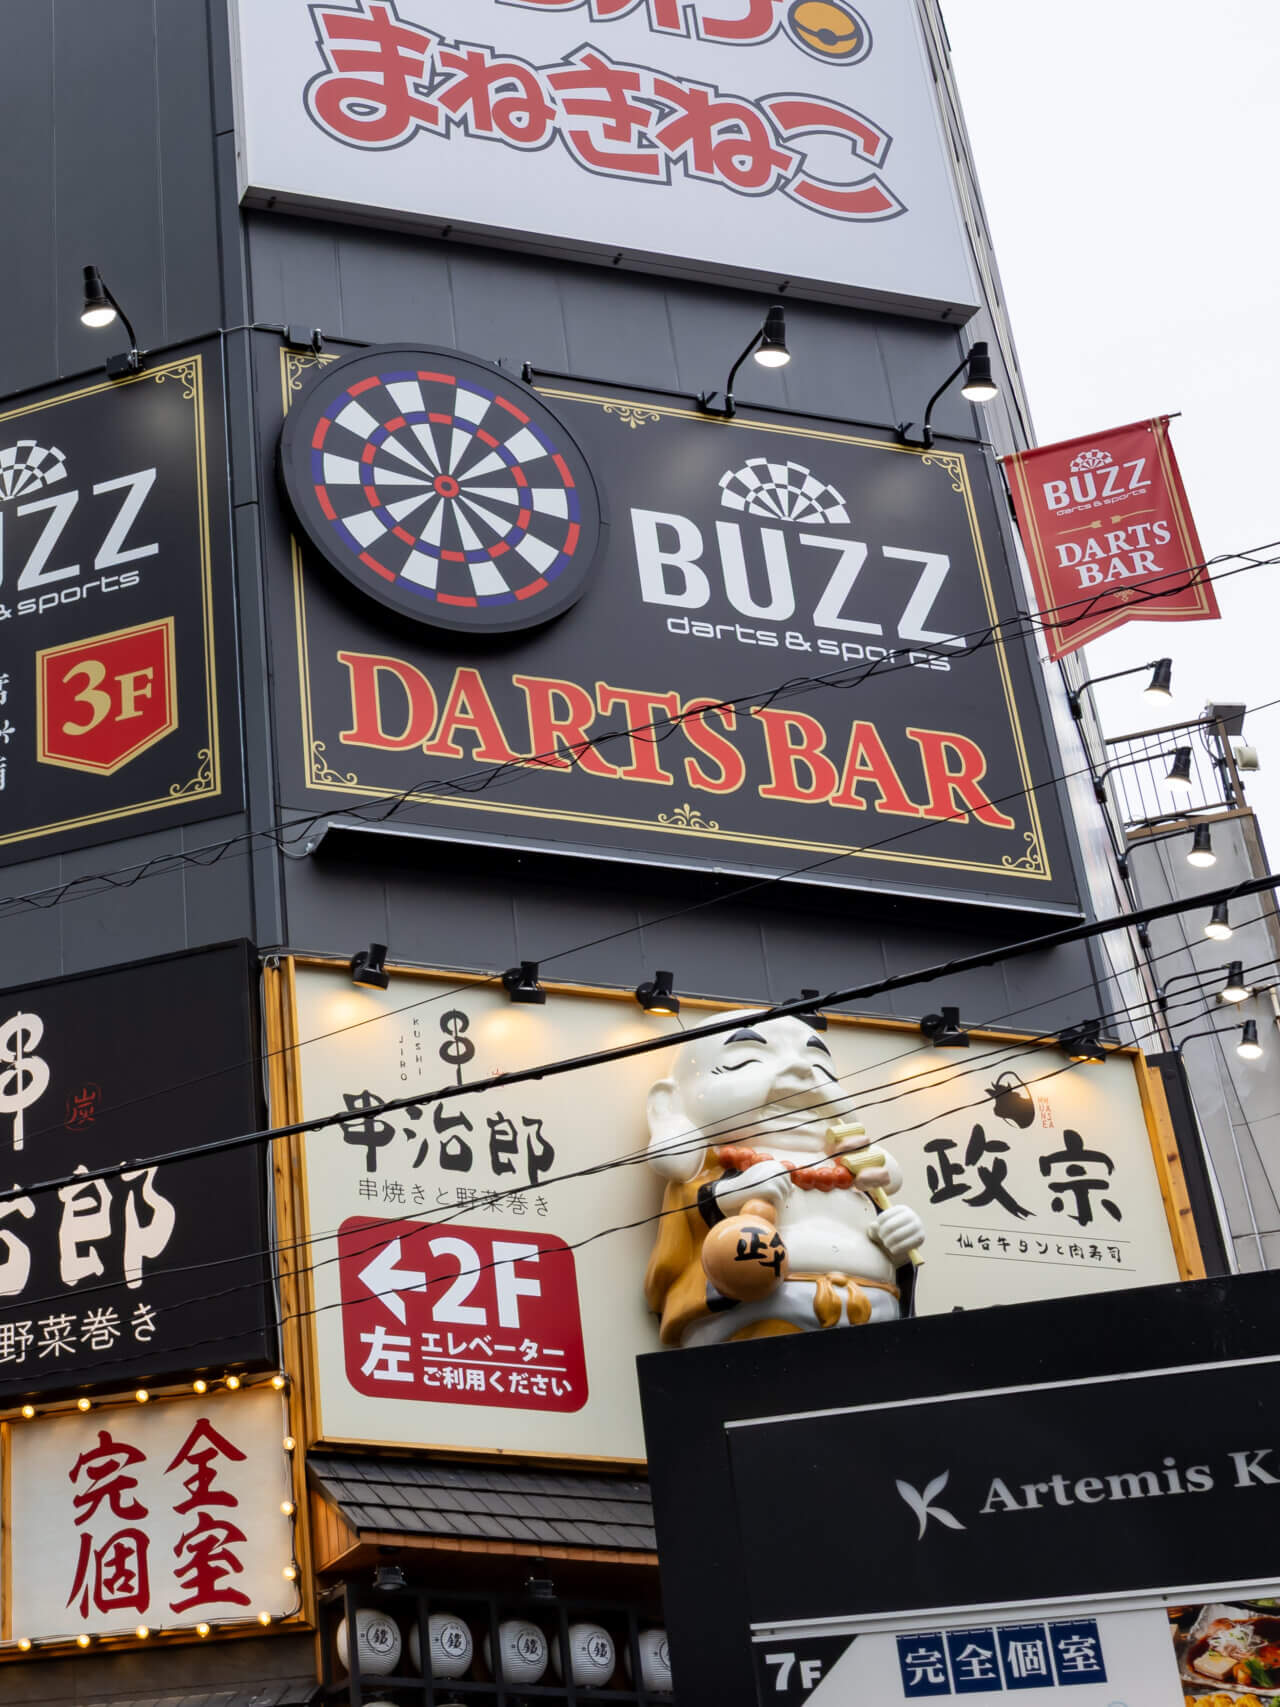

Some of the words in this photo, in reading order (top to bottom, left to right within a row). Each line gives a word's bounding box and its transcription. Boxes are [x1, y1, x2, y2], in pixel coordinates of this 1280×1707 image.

[304, 3, 908, 223] まねきねこ
[1042, 457, 1151, 511] BUZZ
[1055, 520, 1171, 568] DARTS
[1075, 550, 1164, 589] BAR
[17, 570, 140, 616] sports
[630, 507, 966, 648] BUZZ
[667, 616, 779, 647] darts
[785, 631, 812, 652] &
[817, 639, 951, 672] sports
[62, 659, 154, 736] 3F
[337, 650, 746, 795] DARTS
[752, 705, 1014, 830] BAR
[339, 1089, 555, 1186] 串治郎
[359, 1177, 550, 1217] 串焼きと野菜巻き
[924, 1123, 1123, 1227] 政宗
[957, 1233, 1121, 1263] 仙台牛タンと肉寿司
[428, 1236, 541, 1329] 2F
[360, 1325, 414, 1383] 左
[421, 1332, 565, 1363] エレベーター
[423, 1366, 573, 1397] ご利用ください
[69, 1417, 249, 1526] 完全
[980, 1456, 1214, 1514] Artemis
[66, 1517, 252, 1620] 個室
[765, 1652, 822, 1691] 7F
[905, 1635, 1101, 1686] 完全個室
